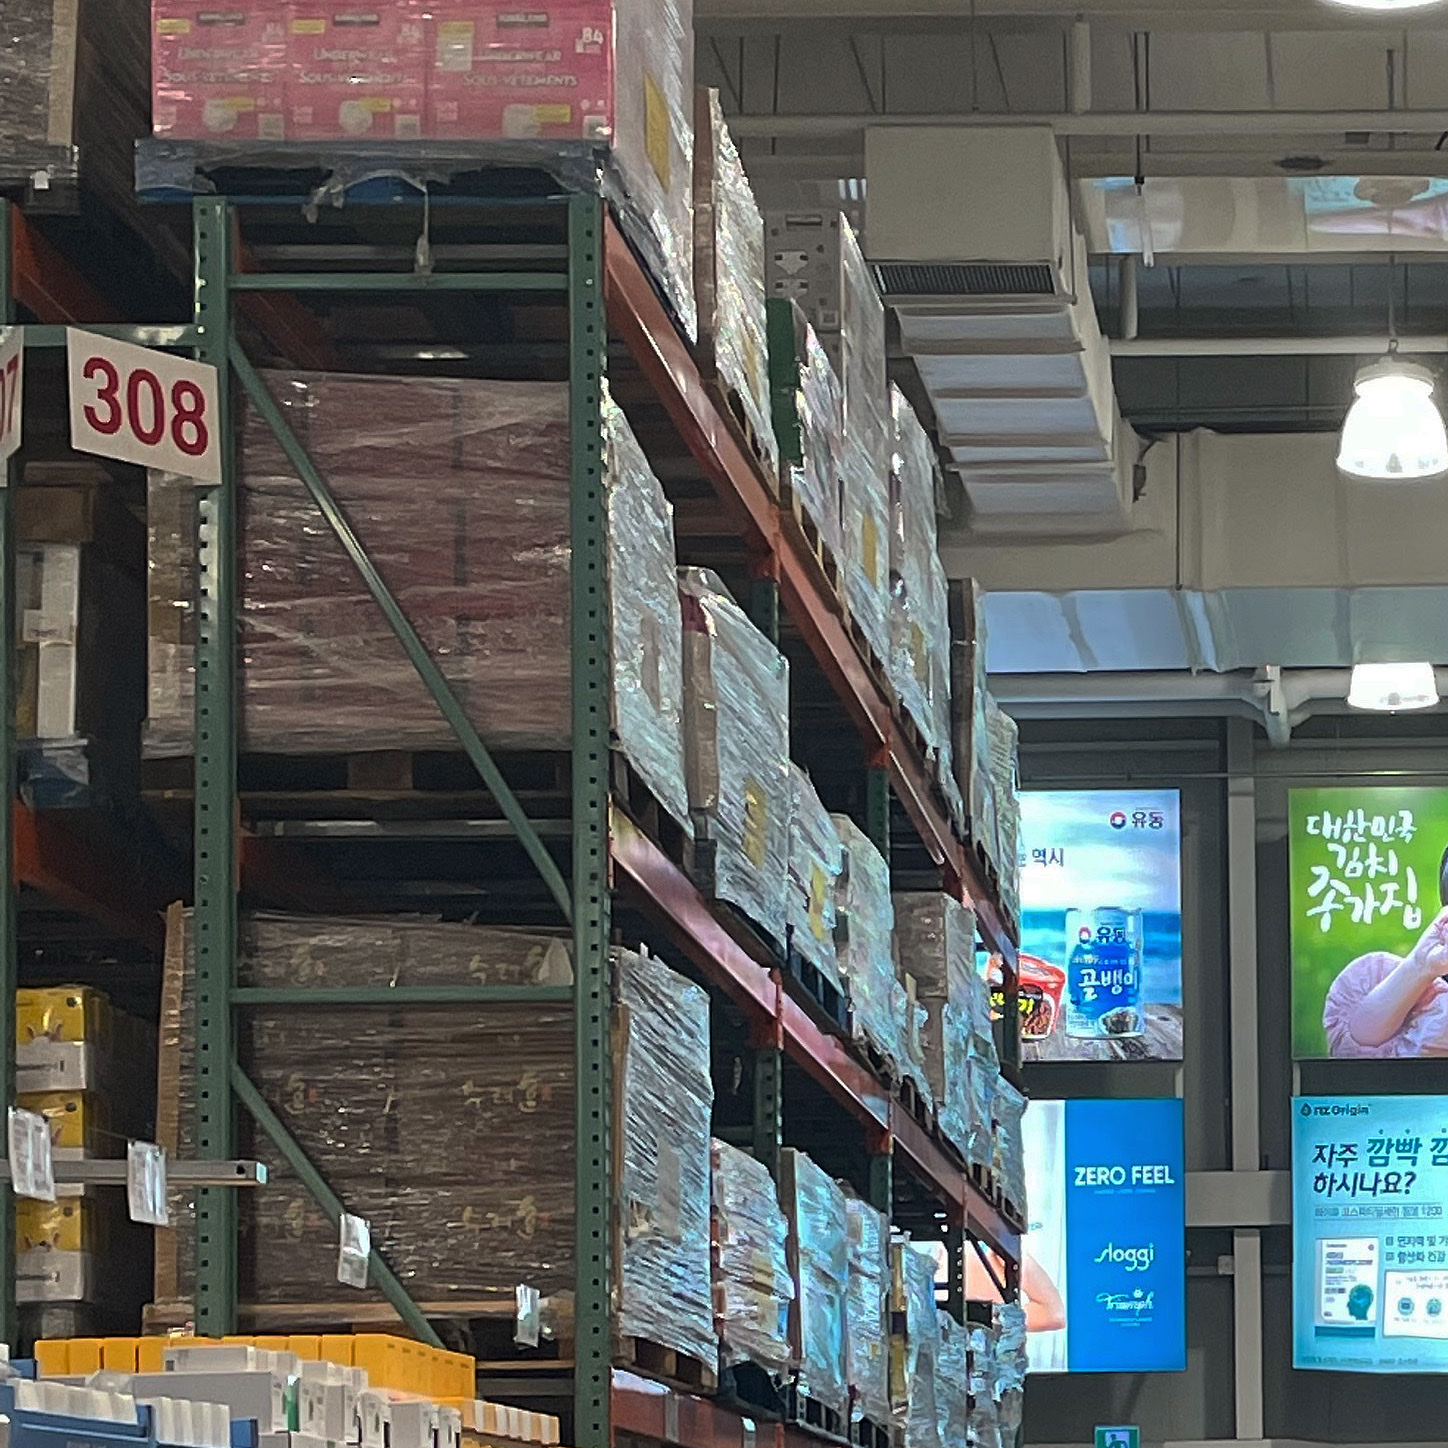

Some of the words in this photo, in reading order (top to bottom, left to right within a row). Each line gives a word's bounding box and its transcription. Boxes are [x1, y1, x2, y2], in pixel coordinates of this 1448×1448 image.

[83, 356, 209, 456] 308
[1131, 811, 1164, 829] 유동
[1306, 808, 1417, 843] 대한민국
[1031, 848, 1065, 868] 역시
[1327, 842, 1398, 879] 김치
[1306, 866, 1422, 933] 종가집
[1078, 968, 1138, 1001] 골뱅이
[1311, 1143, 1359, 1168] 자주
[1366, 1137, 1423, 1167] 깜빡
[1074, 1166, 1126, 1186] ZERO
[1131, 1165, 1175, 1184] FEEL
[1312, 1171, 1417, 1198] 하시나요?
[1093, 1242, 1154, 1272] sloggi
